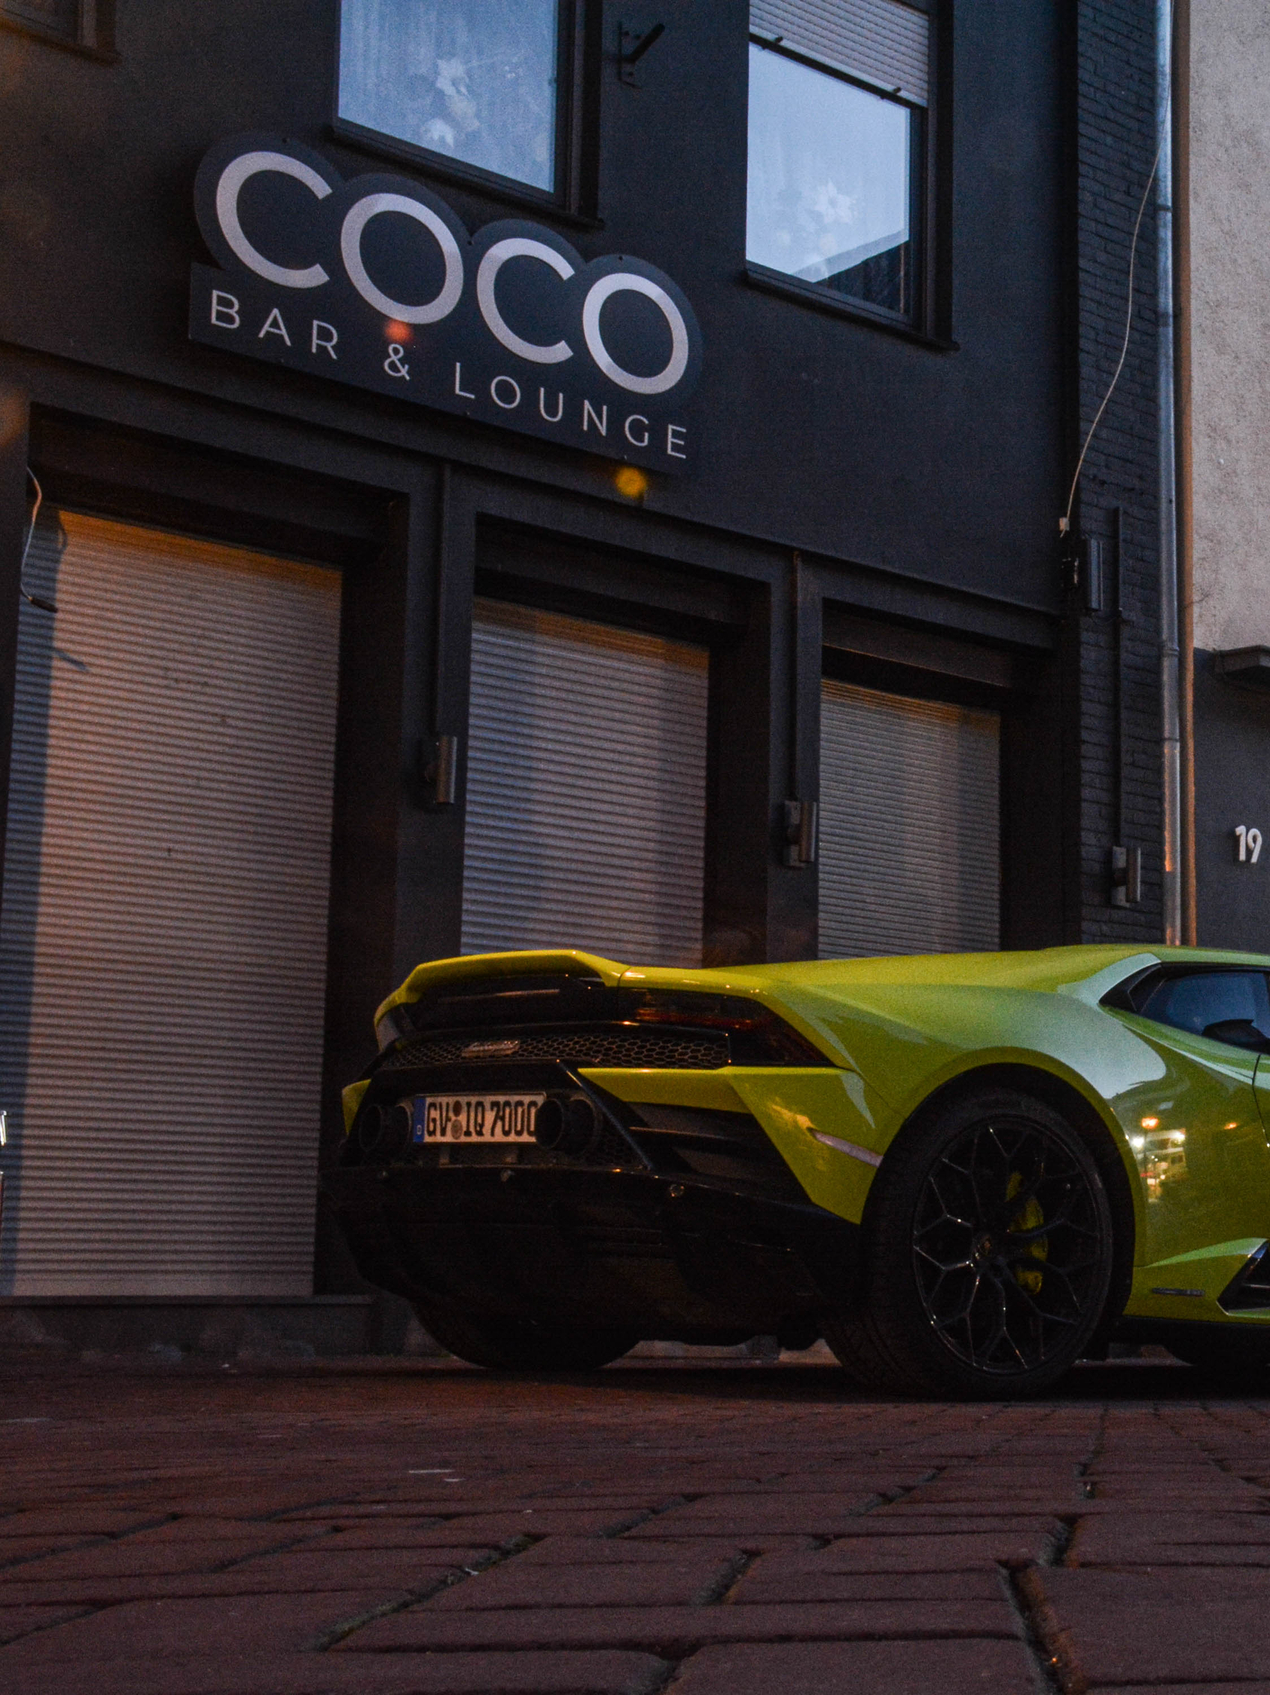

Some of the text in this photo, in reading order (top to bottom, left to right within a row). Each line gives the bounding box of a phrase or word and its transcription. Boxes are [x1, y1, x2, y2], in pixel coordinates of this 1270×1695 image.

[216, 151, 690, 395] COCO
[211, 289, 688, 460] BAR & LOUNGE
[1235, 825, 1263, 864] 19
[426, 1100, 539, 1137] GV IQ 7000
